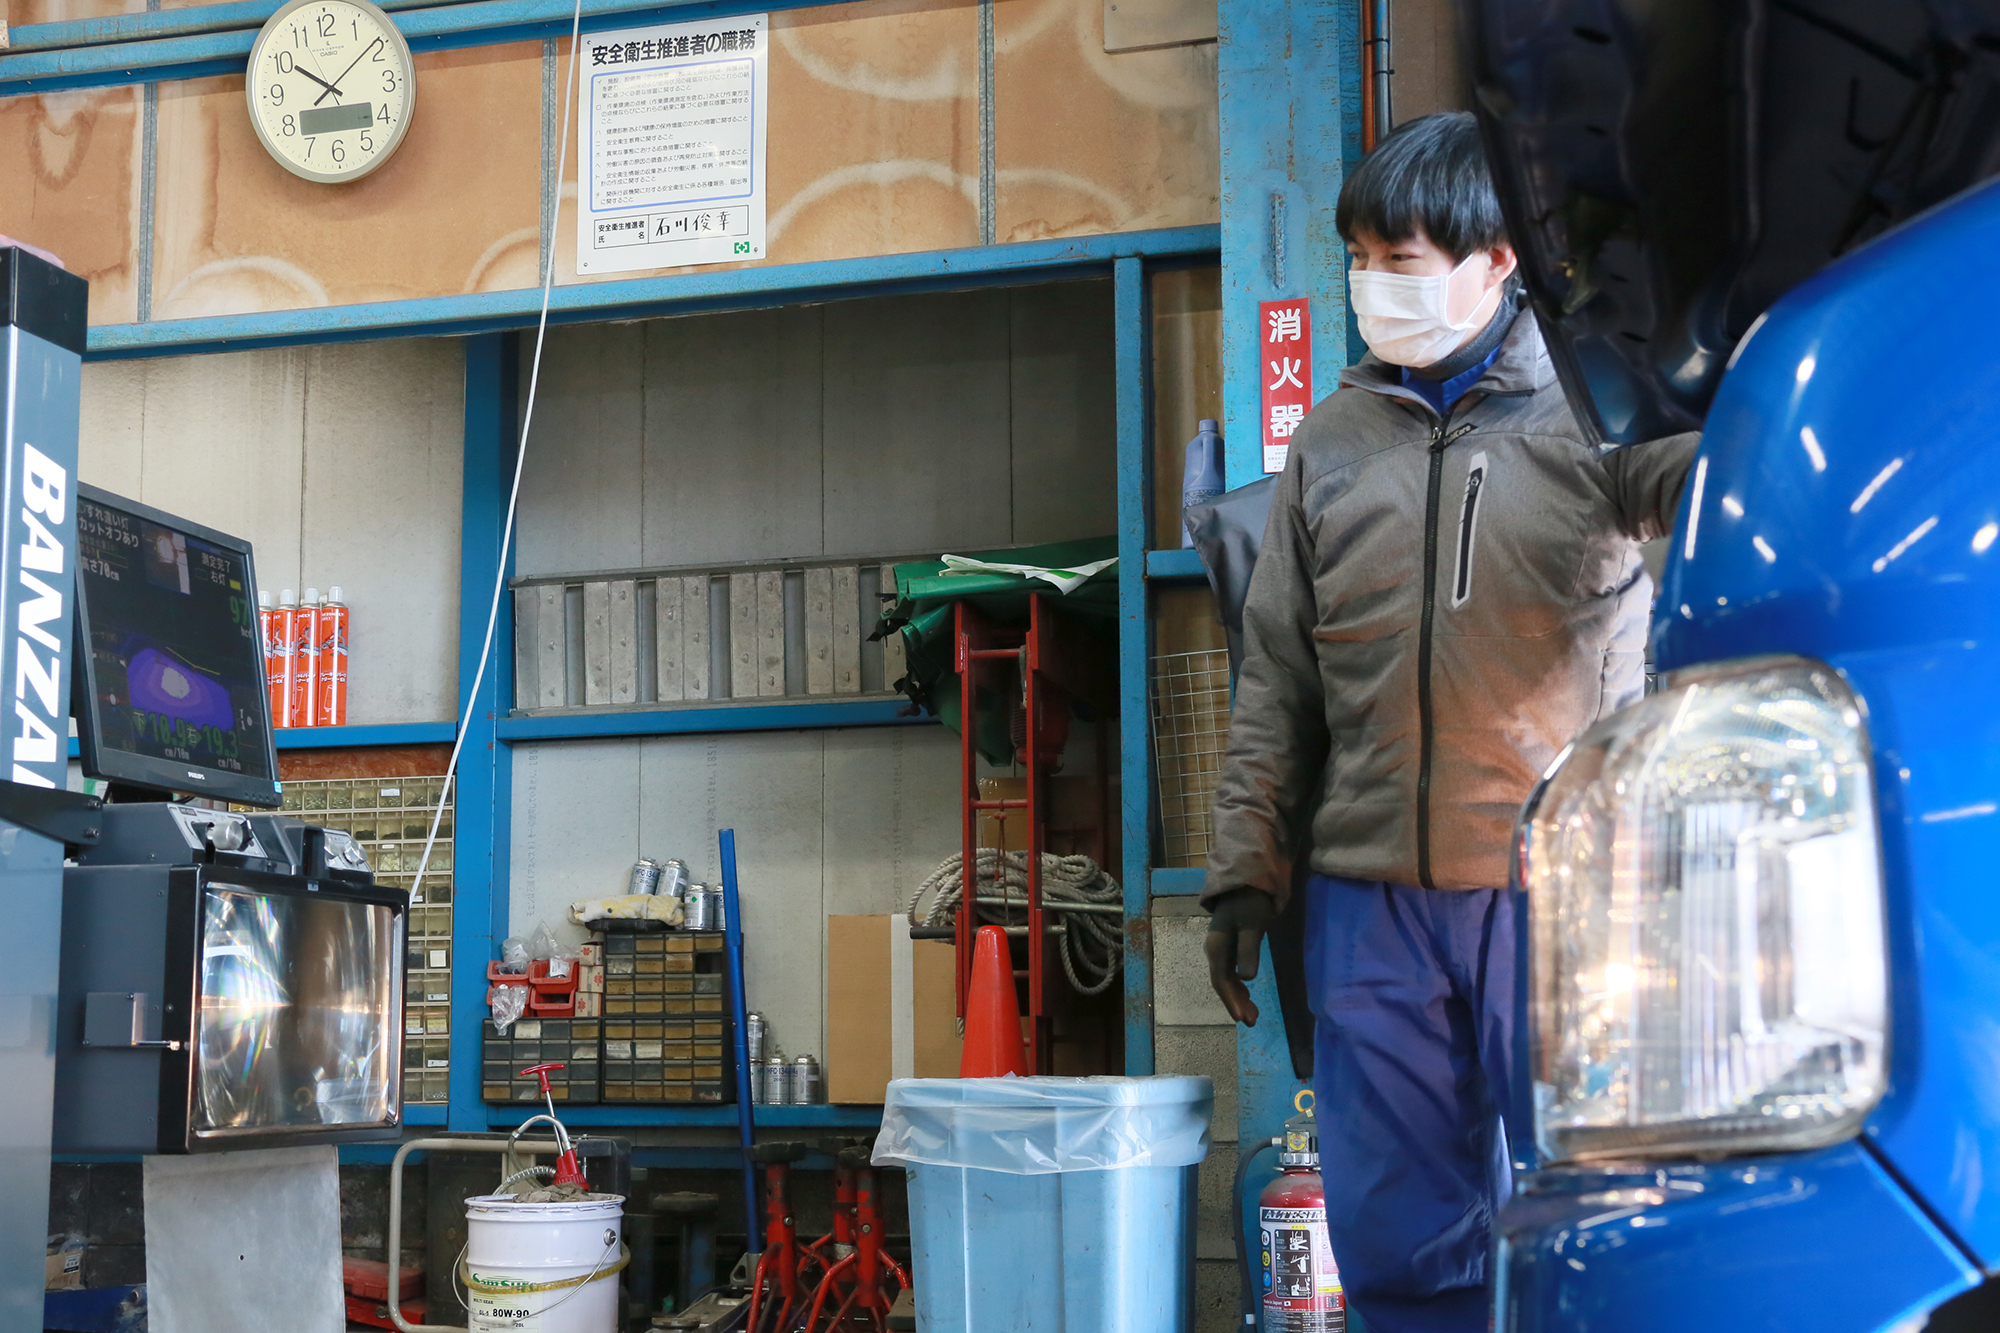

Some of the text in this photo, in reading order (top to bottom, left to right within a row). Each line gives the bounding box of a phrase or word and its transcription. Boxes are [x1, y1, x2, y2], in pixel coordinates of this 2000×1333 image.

[292, 25, 308, 49] 11
[315, 13, 336, 38] 12
[351, 19, 358, 42] 1
[372, 38, 385, 63] 2
[592, 29, 756, 66] 安全衛生推進者の職務
[273, 50, 294, 75] 10
[381, 69, 396, 93] 3
[270, 83, 284, 107] 9
[281, 114, 296, 137] 8
[376, 103, 391, 125] 4
[303, 136, 316, 159] 7
[331, 139, 345, 163] 6
[360, 129, 373, 152] 5
[598, 220, 645, 232] 安全衛生推進者
[598, 231, 645, 243] 氏 名
[1268, 307, 1305, 438] 消火器
[79, 516, 139, 548] カットオフあり
[201, 552, 231, 573] 測定完了
[210, 571, 226, 586] 右灯
[12, 442, 67, 789] BANZAI
[229, 595, 248, 626] 97
[133, 711, 145, 731] 下
[187, 726, 198, 744] 右
[202, 724, 239, 759] 19.3
[492, 1308, 530, 1318] 80W-90
